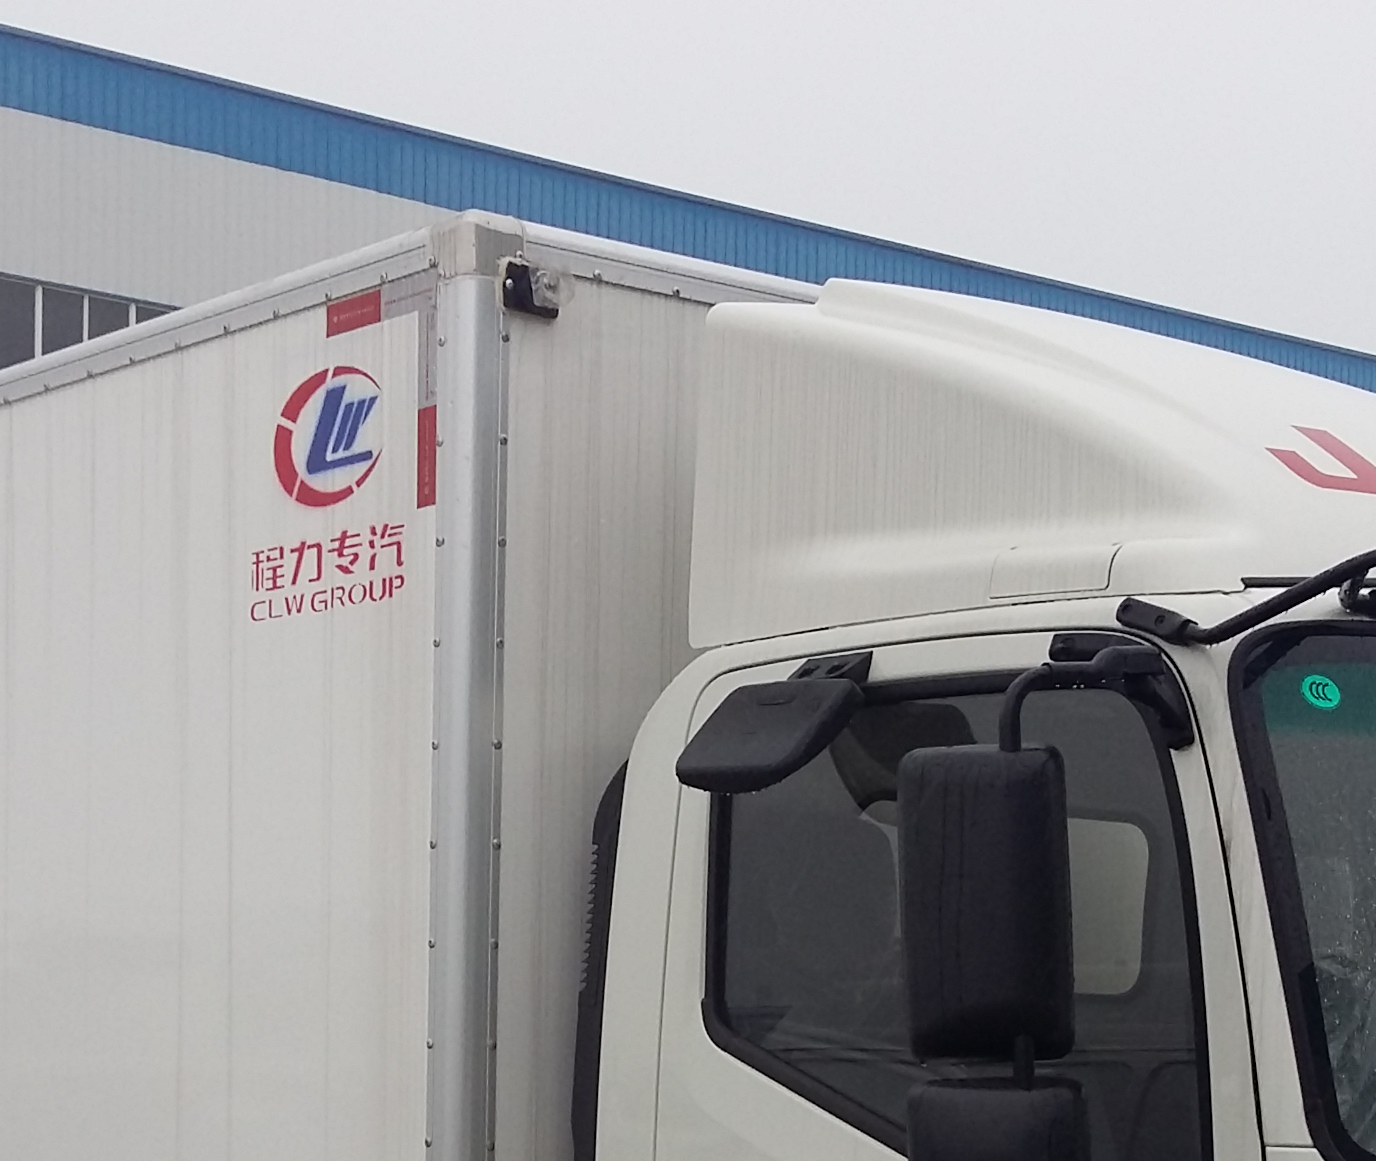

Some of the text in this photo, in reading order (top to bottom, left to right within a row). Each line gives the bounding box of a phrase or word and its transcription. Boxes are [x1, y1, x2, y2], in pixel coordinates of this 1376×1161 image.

[251, 523, 405, 592] 程力专汽
[250, 574, 405, 622] CLW GROUP
